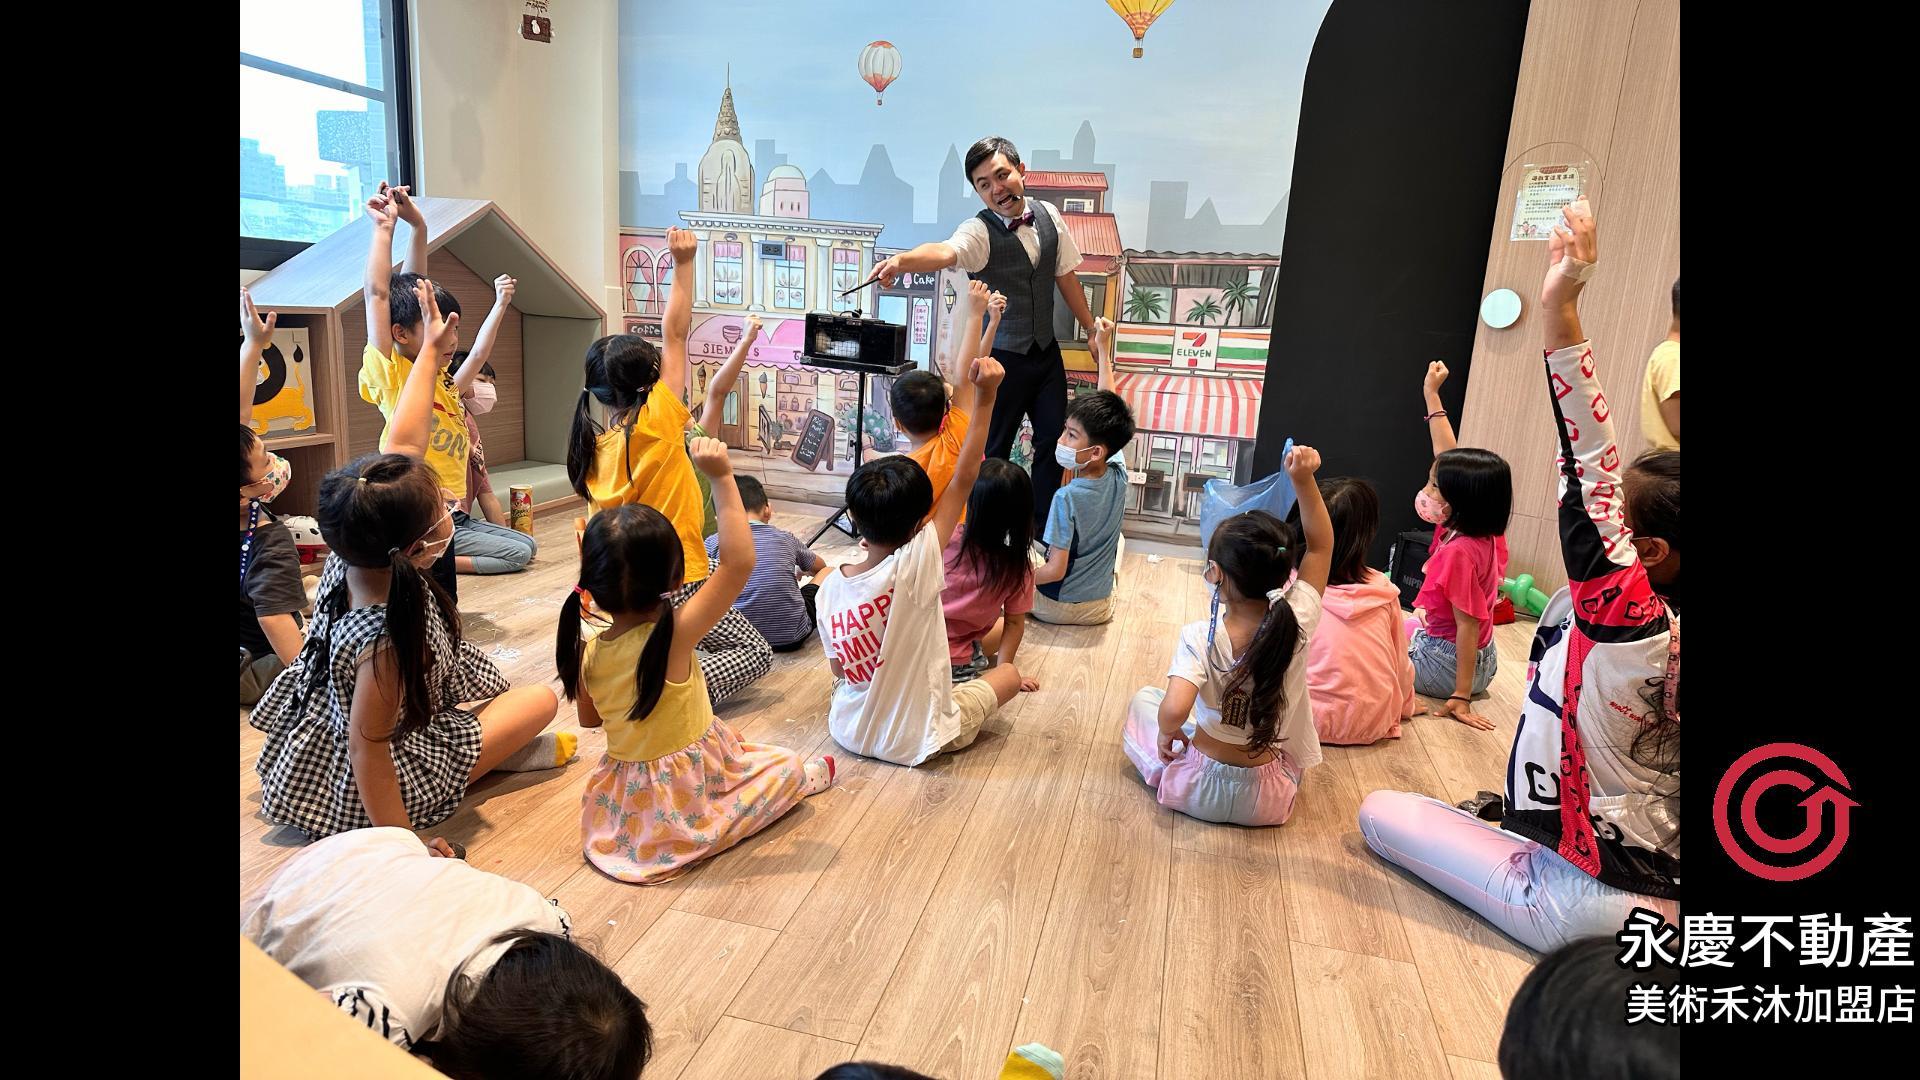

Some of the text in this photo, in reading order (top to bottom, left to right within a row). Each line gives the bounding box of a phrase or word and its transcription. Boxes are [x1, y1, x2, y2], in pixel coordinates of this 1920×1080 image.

[913, 273, 935, 286] Cake
[1176, 348, 1212, 358] ELEVEN
[831, 588, 895, 639] HAPP
[832, 620, 887, 665] SMIL
